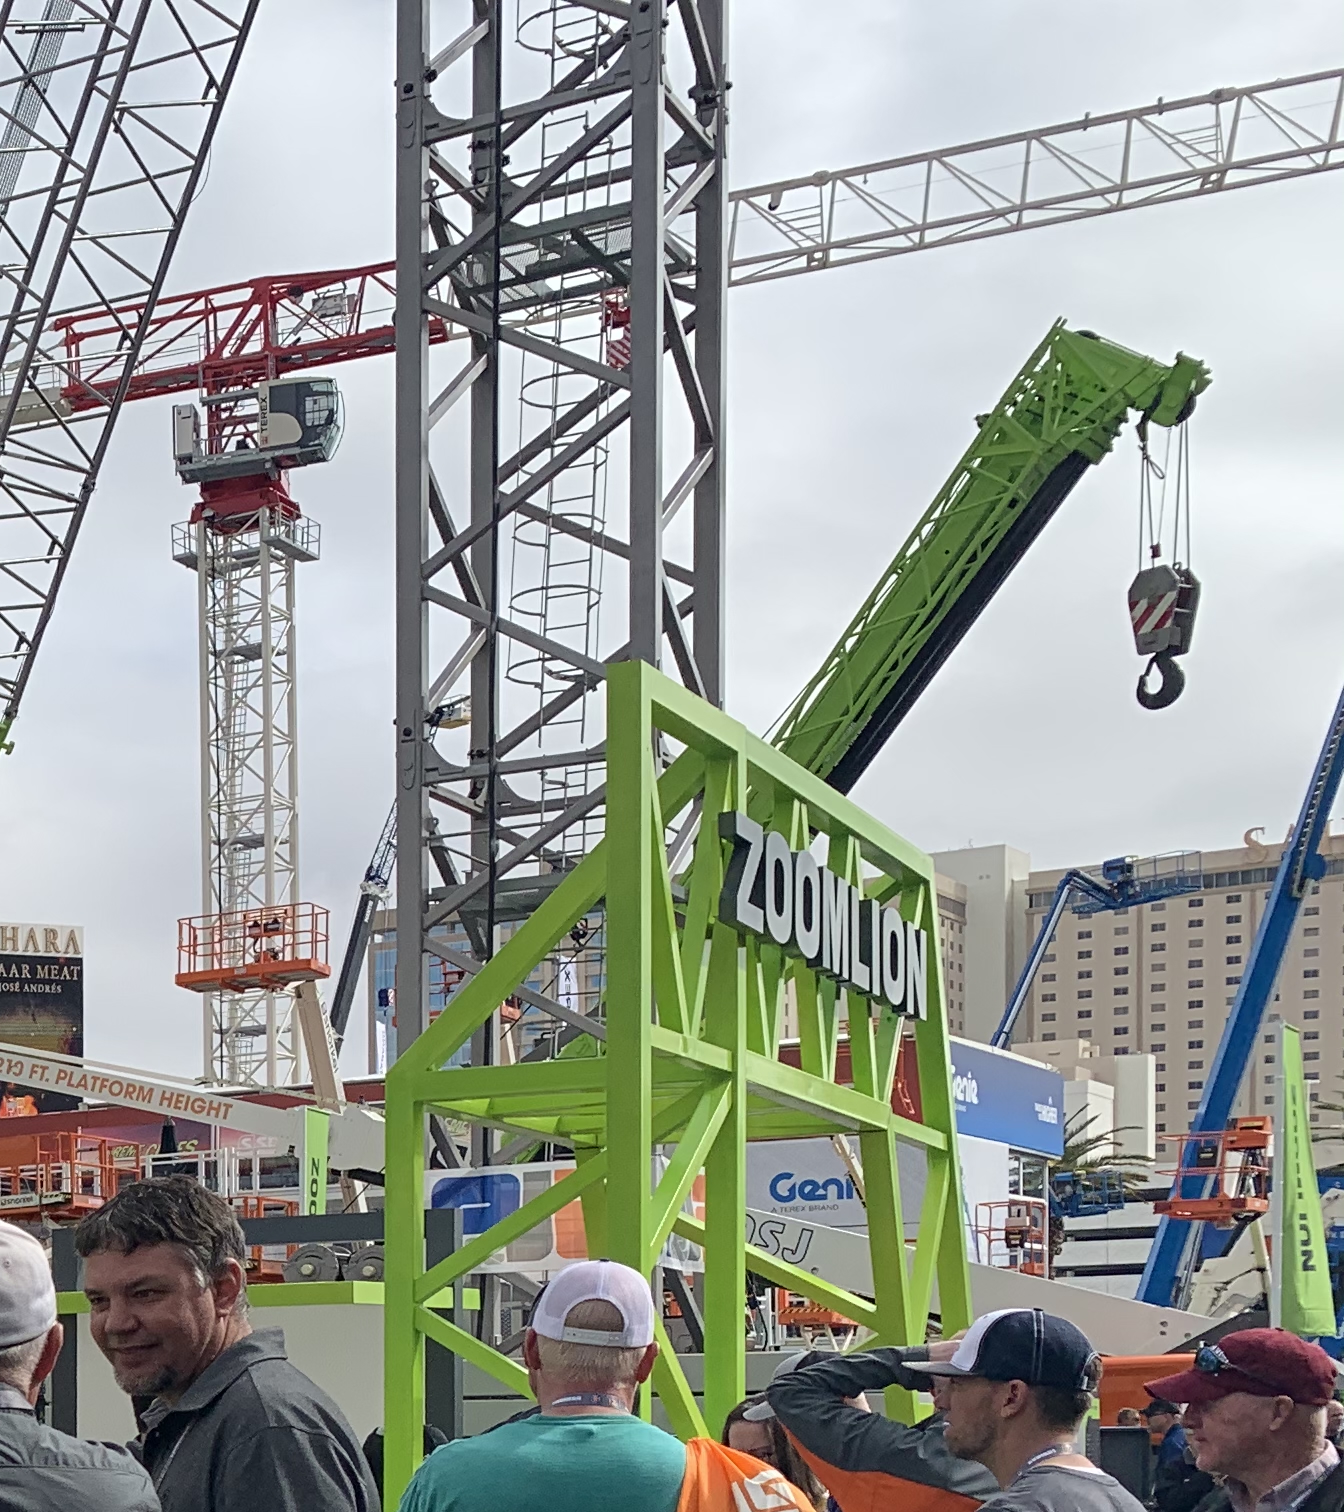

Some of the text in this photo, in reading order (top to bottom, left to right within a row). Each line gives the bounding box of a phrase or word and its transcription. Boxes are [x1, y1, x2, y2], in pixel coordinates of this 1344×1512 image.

[260, 396, 268, 434] TEREX
[734, 809, 927, 1022] ZOOMLION
[36, 964, 81, 981] MEAT
[23, 983, 62, 994] ANDRÉS
[28, 1063, 51, 1083] FT.
[55, 1068, 154, 1105] PLATFORM
[159, 1090, 234, 1121] HEIGHT
[780, 1205, 807, 1213] TEREX
[808, 1203, 840, 1212] BRAND
